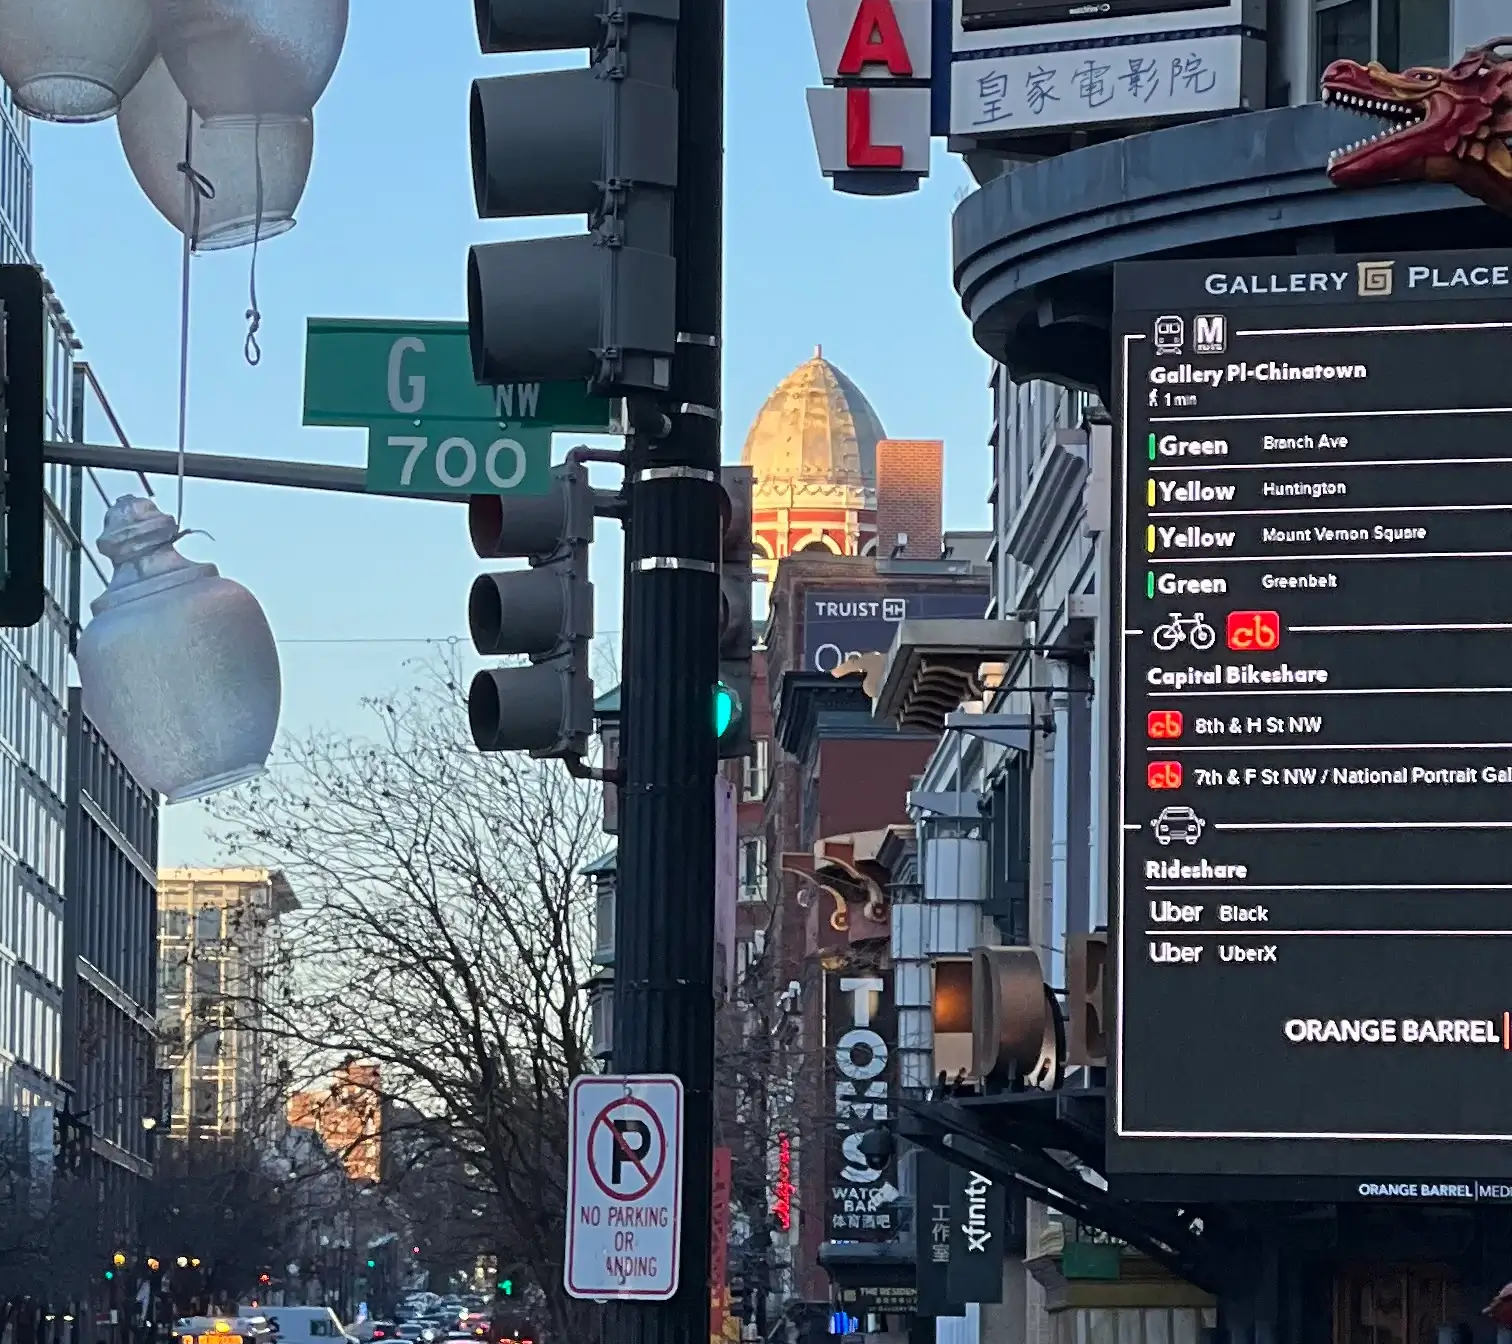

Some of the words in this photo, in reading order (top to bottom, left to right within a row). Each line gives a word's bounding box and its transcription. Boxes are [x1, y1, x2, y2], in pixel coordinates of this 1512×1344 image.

[973, 53, 1217, 126] 皇家電影院
[1205, 270, 1348, 296] GALLERY
[1408, 265, 1509, 288] PLACE
[387, 336, 427, 414] G
[495, 382, 539, 417] NW
[1149, 364, 1223, 387] Gallery
[1227, 362, 1368, 383] Pl-Chinatown
[1158, 435, 1228, 457] Green
[1262, 434, 1314, 450] Branch
[1318, 433, 1349, 450] Ave
[387, 436, 527, 489] 700
[1159, 481, 1236, 503] Yellow
[1262, 480, 1347, 498] Huntington
[1159, 527, 1236, 549] Yellow
[1262, 527, 1311, 543] Mount
[1315, 526, 1369, 542] Vernon
[1373, 524, 1427, 542] Square
[1158, 574, 1227, 595] Green
[1261, 573, 1338, 590] Greenbelt
[815, 601, 879, 617] TRUIST
[1147, 666, 1221, 688] Capital
[1227, 664, 1328, 685] Bikeshare
[1195, 717, 1224, 734] 8th
[1228, 718, 1242, 734] &
[1247, 717, 1261, 733] H
[1266, 717, 1285, 733] St
[1289, 716, 1322, 733] NW
[1194, 768, 1224, 786] 7th
[1227, 769, 1241, 785] &
[1245, 769, 1257, 785] F
[1261, 768, 1280, 785] St
[1284, 768, 1317, 784] NW
[1320, 768, 1329, 785] /
[1333, 767, 1408, 785] National
[1412, 766, 1478, 784] Portrait
[1482, 765, 1512, 783] Gal
[1145, 859, 1248, 881] Rideshare
[1150, 901, 1203, 922] Uber
[1219, 904, 1269, 923] Black
[1150, 942, 1203, 964] Uber
[1219, 944, 1277, 964] UberX
[1284, 1019, 1397, 1043] ORANGE
[1402, 1019, 1500, 1043] BARREL
[831, 1187, 882, 1201] WATC
[1358, 1183, 1418, 1198] ORANGE
[1421, 1183, 1473, 1198] BARREL
[581, 1206, 601, 1226] NO
[608, 1206, 669, 1228] PARKING
[844, 1200, 879, 1213] BAR
[961, 1170, 993, 1252] xfinity
[615, 1231, 634, 1252] OR
